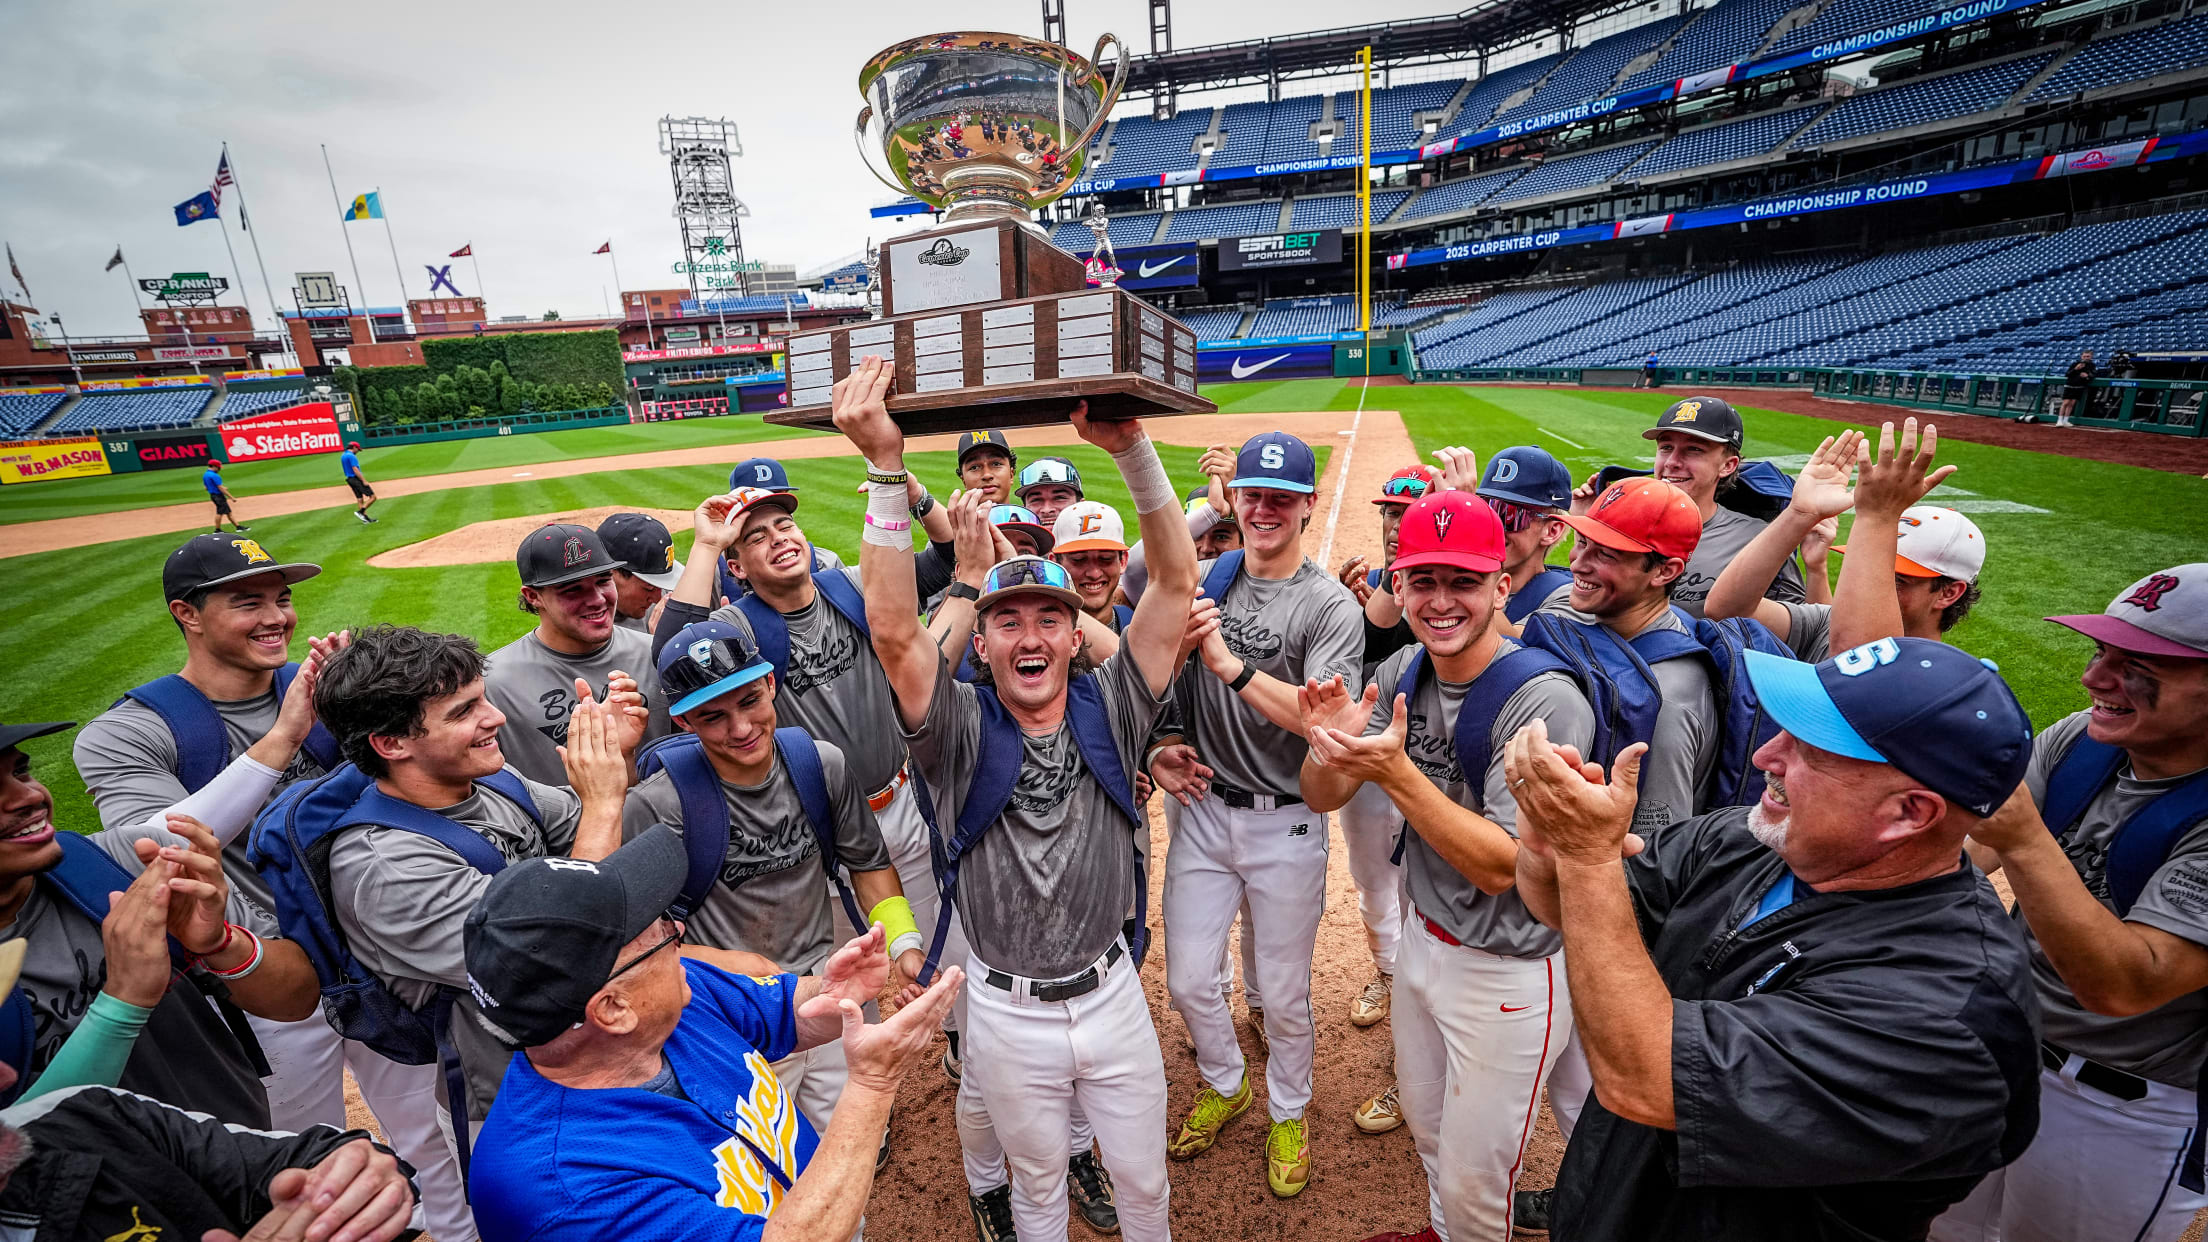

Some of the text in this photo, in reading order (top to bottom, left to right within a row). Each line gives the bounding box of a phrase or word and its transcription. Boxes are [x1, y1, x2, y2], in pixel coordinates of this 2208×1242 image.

[1811, 0, 2007, 59] CHAMPIONSHIP ROUND
[1498, 97, 1618, 138] 2025 CARPENTER CUP
[1255, 156, 1365, 174] CHAMPIONSHIP ROUND
[1065, 179, 1116, 194] NTER CUP
[1744, 180, 1928, 218] CHAMPIONSHIP ROUND
[1238, 232, 1321, 253] ESPN BET
[1445, 232, 1561, 260] 2025 CARPENTER CUP
[1247, 249, 1311, 261] SPORTSBOOK
[673, 259, 763, 274] Citizens Bank
[145, 279, 222, 290] CP RANKIN
[706, 275, 735, 288] Park
[164, 292, 212, 300] ROOFTOP
[1348, 349, 1363, 359] 330
[346, 423, 359, 433] 409
[498, 426, 512, 435] 401
[38, 437, 90, 446] ASPLUNDH
[971, 431, 991, 443] M
[108, 442, 128, 453] 387
[138, 443, 208, 461] GIANT
[1260, 443, 1286, 470] S
[754, 465, 773, 482] D
[1491, 458, 1519, 483] D
[1078, 513, 1102, 535] C
[2121, 573, 2180, 612] R
[1834, 636, 1901, 677] S
[723, 857, 796, 882] Carpenter
